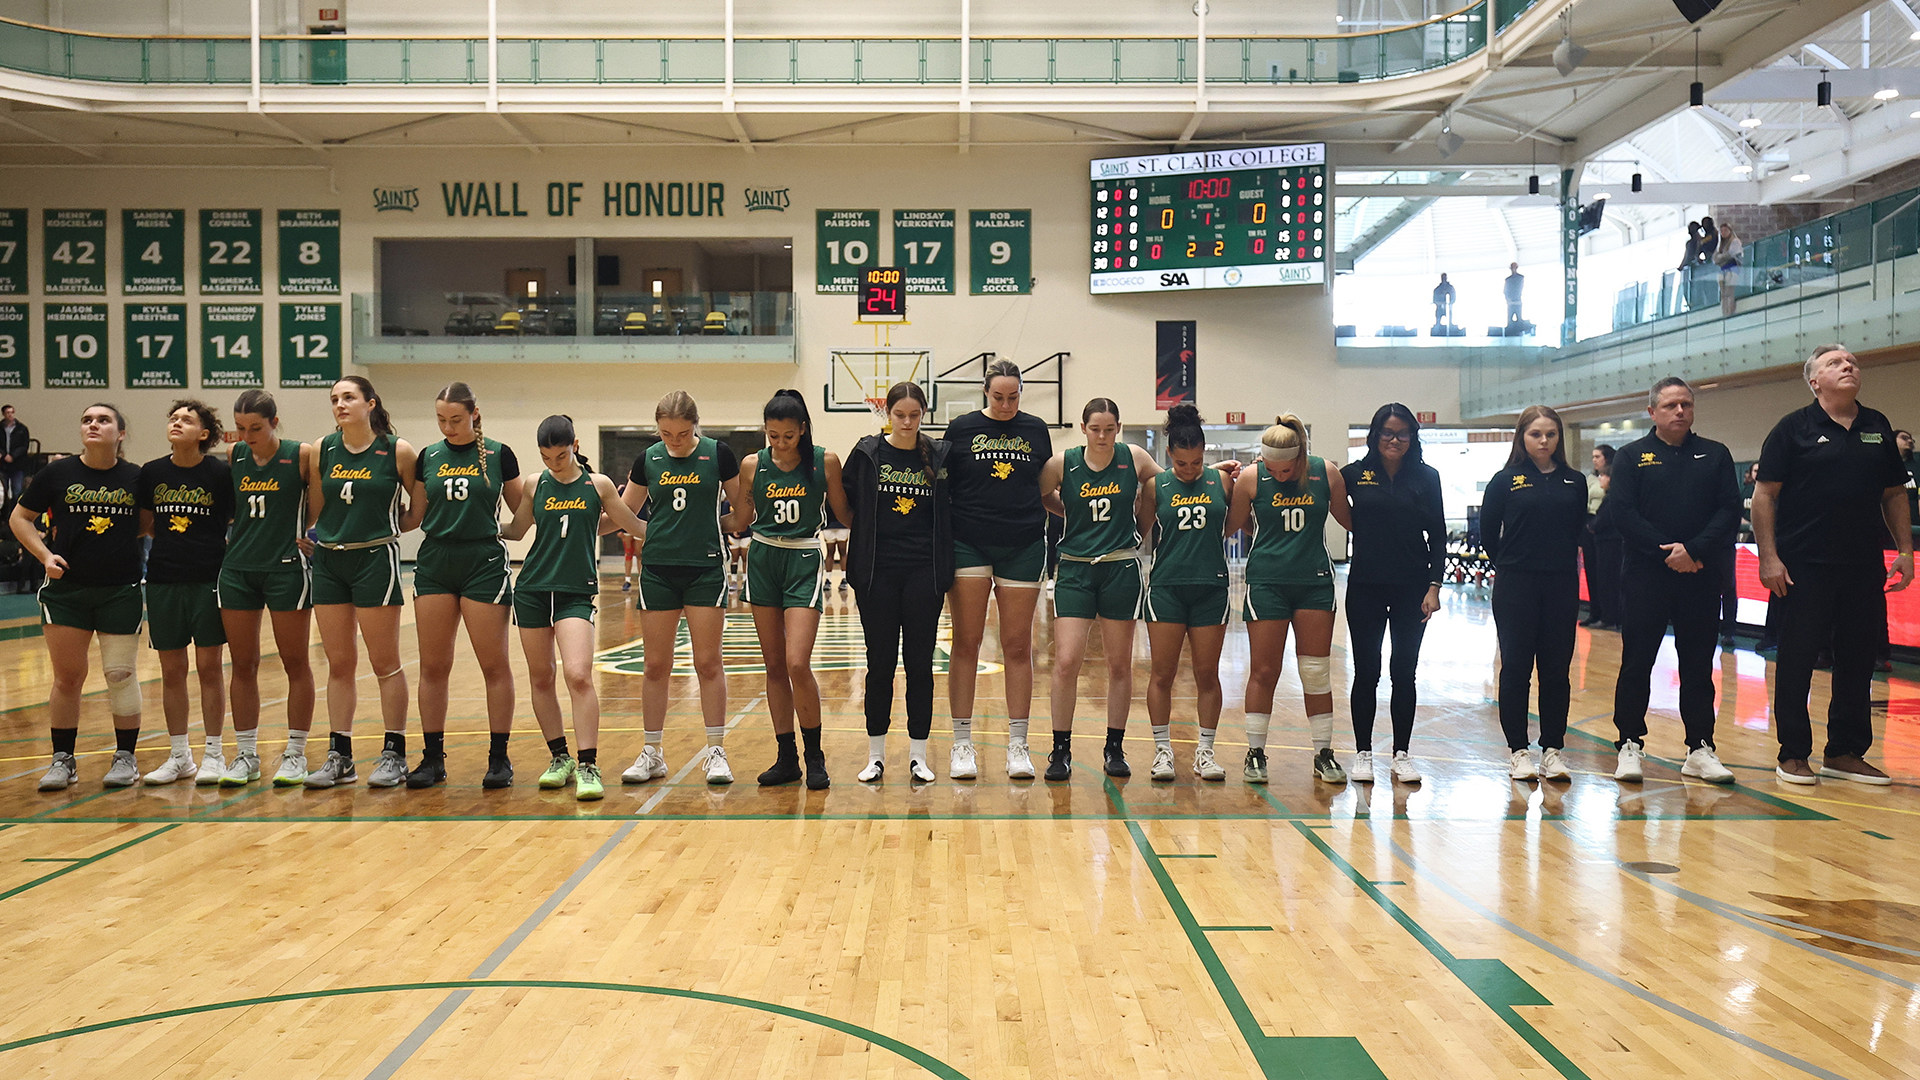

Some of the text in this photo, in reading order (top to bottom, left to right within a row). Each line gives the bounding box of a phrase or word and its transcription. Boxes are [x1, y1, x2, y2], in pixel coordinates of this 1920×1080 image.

[1138, 146, 1318, 173] ST. CLAIR COLLEGE
[1100, 161, 1129, 176] SAINTS
[1188, 178, 1231, 200] 10:00
[1298, 177, 1306, 189] 0
[373, 188, 420, 208] SAINTS
[442, 182, 724, 216] WALL OF HONOUR
[744, 188, 790, 208] SAINTS
[1114, 189, 1122, 201] 0
[1239, 189, 1264, 199] GUEST
[1298, 194, 1306, 206] 0
[1114, 206, 1122, 218] 0
[1161, 208, 1174, 230] 0
[1206, 212, 1210, 225] 1
[1253, 202, 1266, 224] 0
[1298, 212, 1306, 224] 0
[1114, 223, 1122, 234] 0
[1298, 230, 1306, 242] 0
[52, 241, 95, 264] 42
[141, 241, 162, 264] 4
[209, 241, 251, 264] 22
[299, 241, 320, 264] 8
[826, 240, 868, 264] 10
[904, 242, 942, 264] 17
[990, 242, 1012, 264] 9
[1093, 240, 1108, 253] 23
[1114, 240, 1122, 252] 0
[1151, 244, 1162, 260] 0
[1186, 242, 1197, 258] 2
[1214, 240, 1224, 256] 2
[1254, 238, 1264, 254] 0
[1275, 248, 1290, 260] 22
[1298, 247, 1306, 259] 0
[1567, 198, 1576, 305] GO SAINTS
[1094, 257, 1108, 270] 30
[1114, 257, 1122, 268] 0
[868, 270, 900, 284] 10:00
[1106, 276, 1144, 286] COGECO
[1160, 273, 1190, 286] SAA
[1280, 266, 1312, 281] SAINTS
[866, 288, 896, 312] 24
[55, 334, 98, 358] 10
[136, 335, 174, 358] 17
[210, 335, 251, 358] 14
[290, 334, 329, 358] 12
[971, 434, 1032, 453] Saints
[975, 452, 1030, 462] BASKETBALL
[330, 464, 372, 480] Saints
[436, 463, 480, 478] Saints
[658, 471, 700, 486] Saints
[880, 464, 932, 487] Saint
[239, 476, 280, 492] Saints
[443, 478, 469, 501] 13
[766, 483, 807, 498] Saints
[1080, 482, 1121, 498] Saints
[65, 483, 136, 506] Saints
[154, 482, 214, 506] Saints
[340, 481, 354, 504] 4
[672, 488, 686, 511] 8
[1170, 492, 1212, 507] Saints
[1272, 492, 1314, 507] Saints
[69, 505, 134, 516] BASKETBALL
[248, 494, 266, 518] 11
[544, 496, 587, 511] Saints
[1088, 498, 1111, 522] 12
[774, 500, 800, 524] 30
[1177, 506, 1206, 530] 23
[1280, 508, 1306, 532] 10
[560, 514, 569, 538] 1
